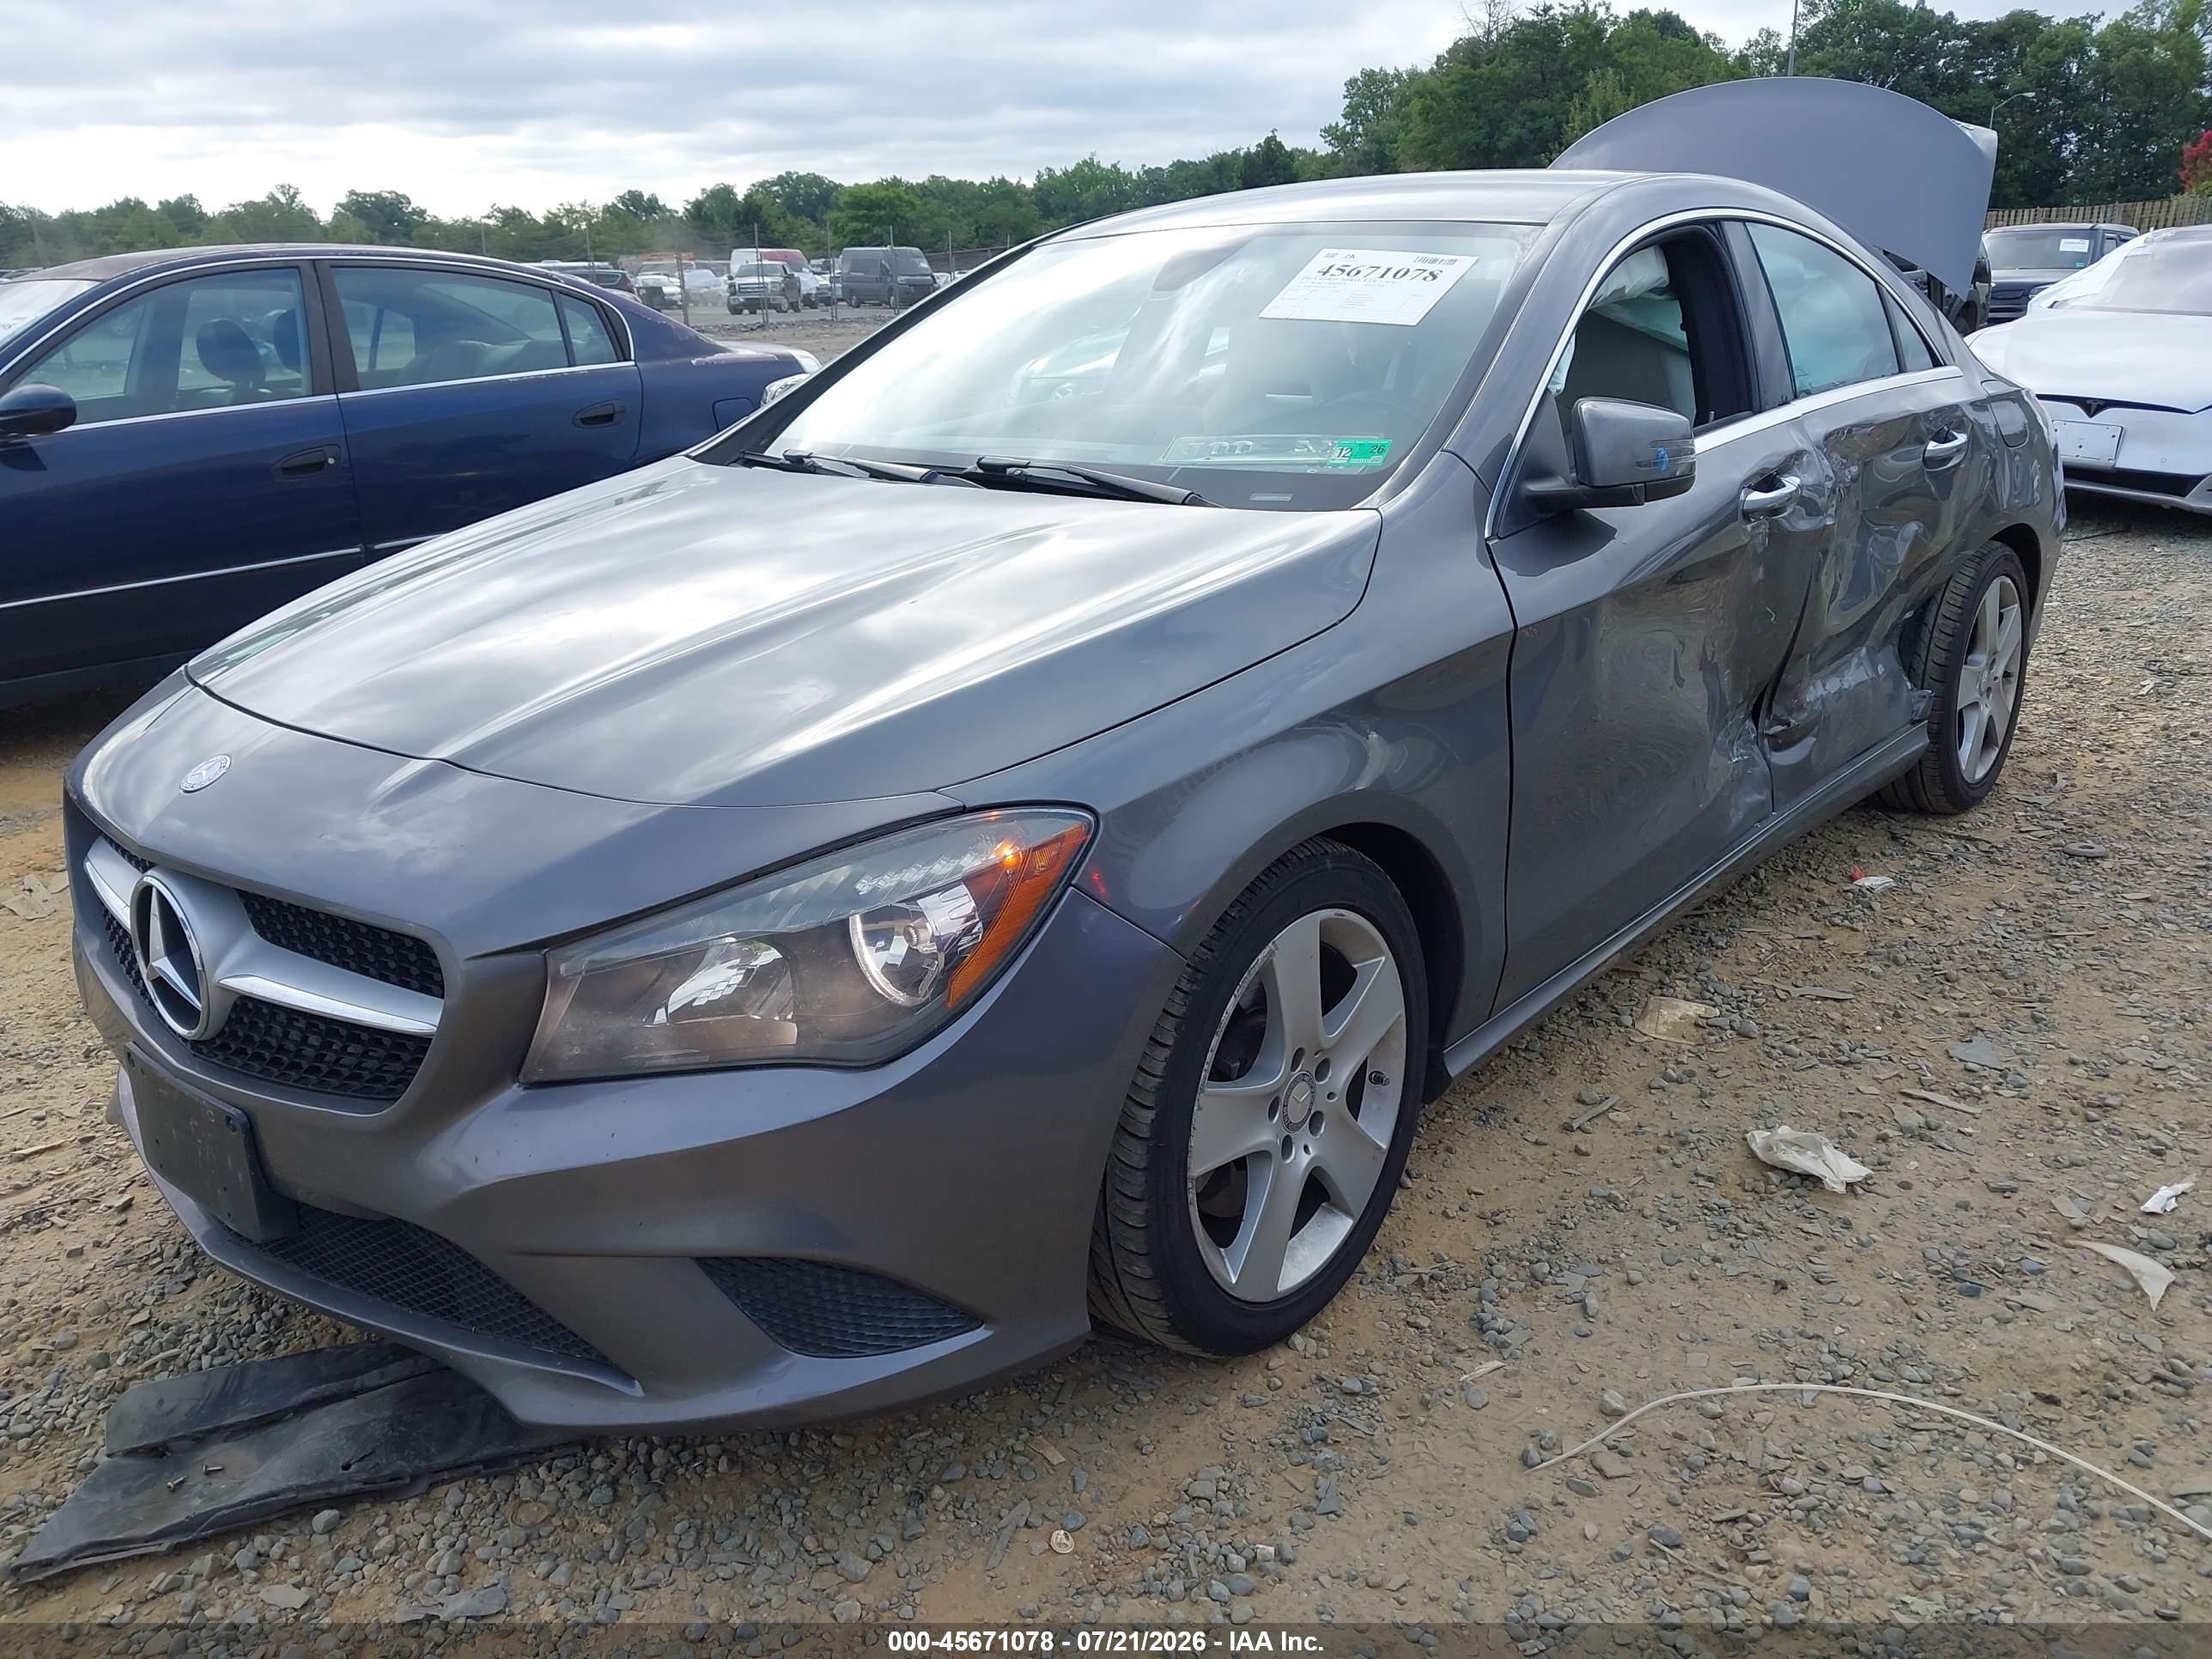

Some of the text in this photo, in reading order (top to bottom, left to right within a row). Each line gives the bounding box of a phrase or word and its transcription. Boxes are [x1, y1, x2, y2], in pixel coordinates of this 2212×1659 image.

[1316, 264, 1443, 282] 45671078
[1337, 447, 1353, 459] 12
[1370, 445, 1386, 454] 26
